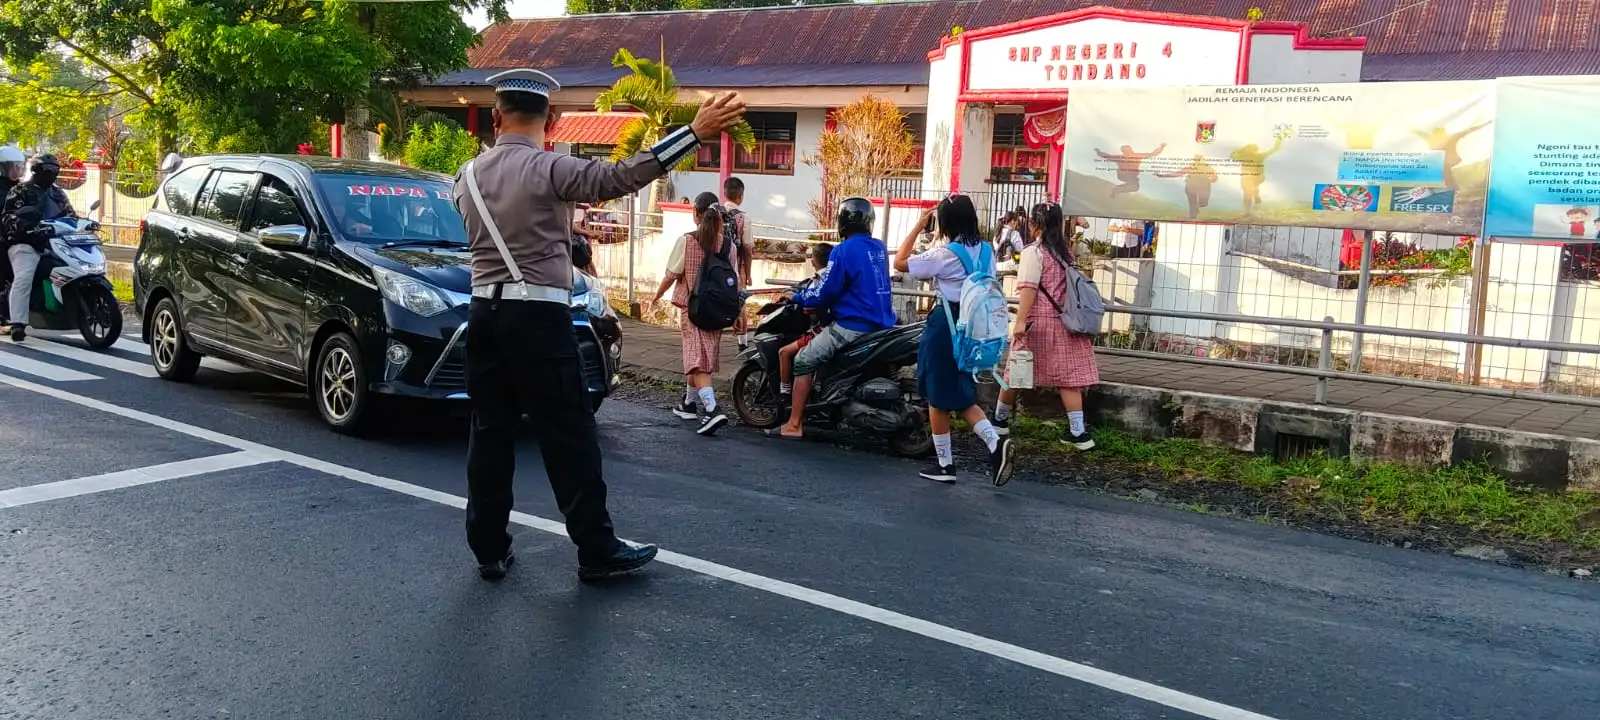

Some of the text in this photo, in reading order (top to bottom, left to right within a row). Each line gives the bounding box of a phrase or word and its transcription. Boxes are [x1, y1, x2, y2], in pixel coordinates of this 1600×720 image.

[1008, 42, 1173, 62] SMP NEGERI 4
[1044, 63, 1147, 81] TONDANO
[1187, 96, 1229, 104] JADILAH
[347, 185, 428, 198] NAPA
[1393, 203, 1450, 213] FREE SEX
